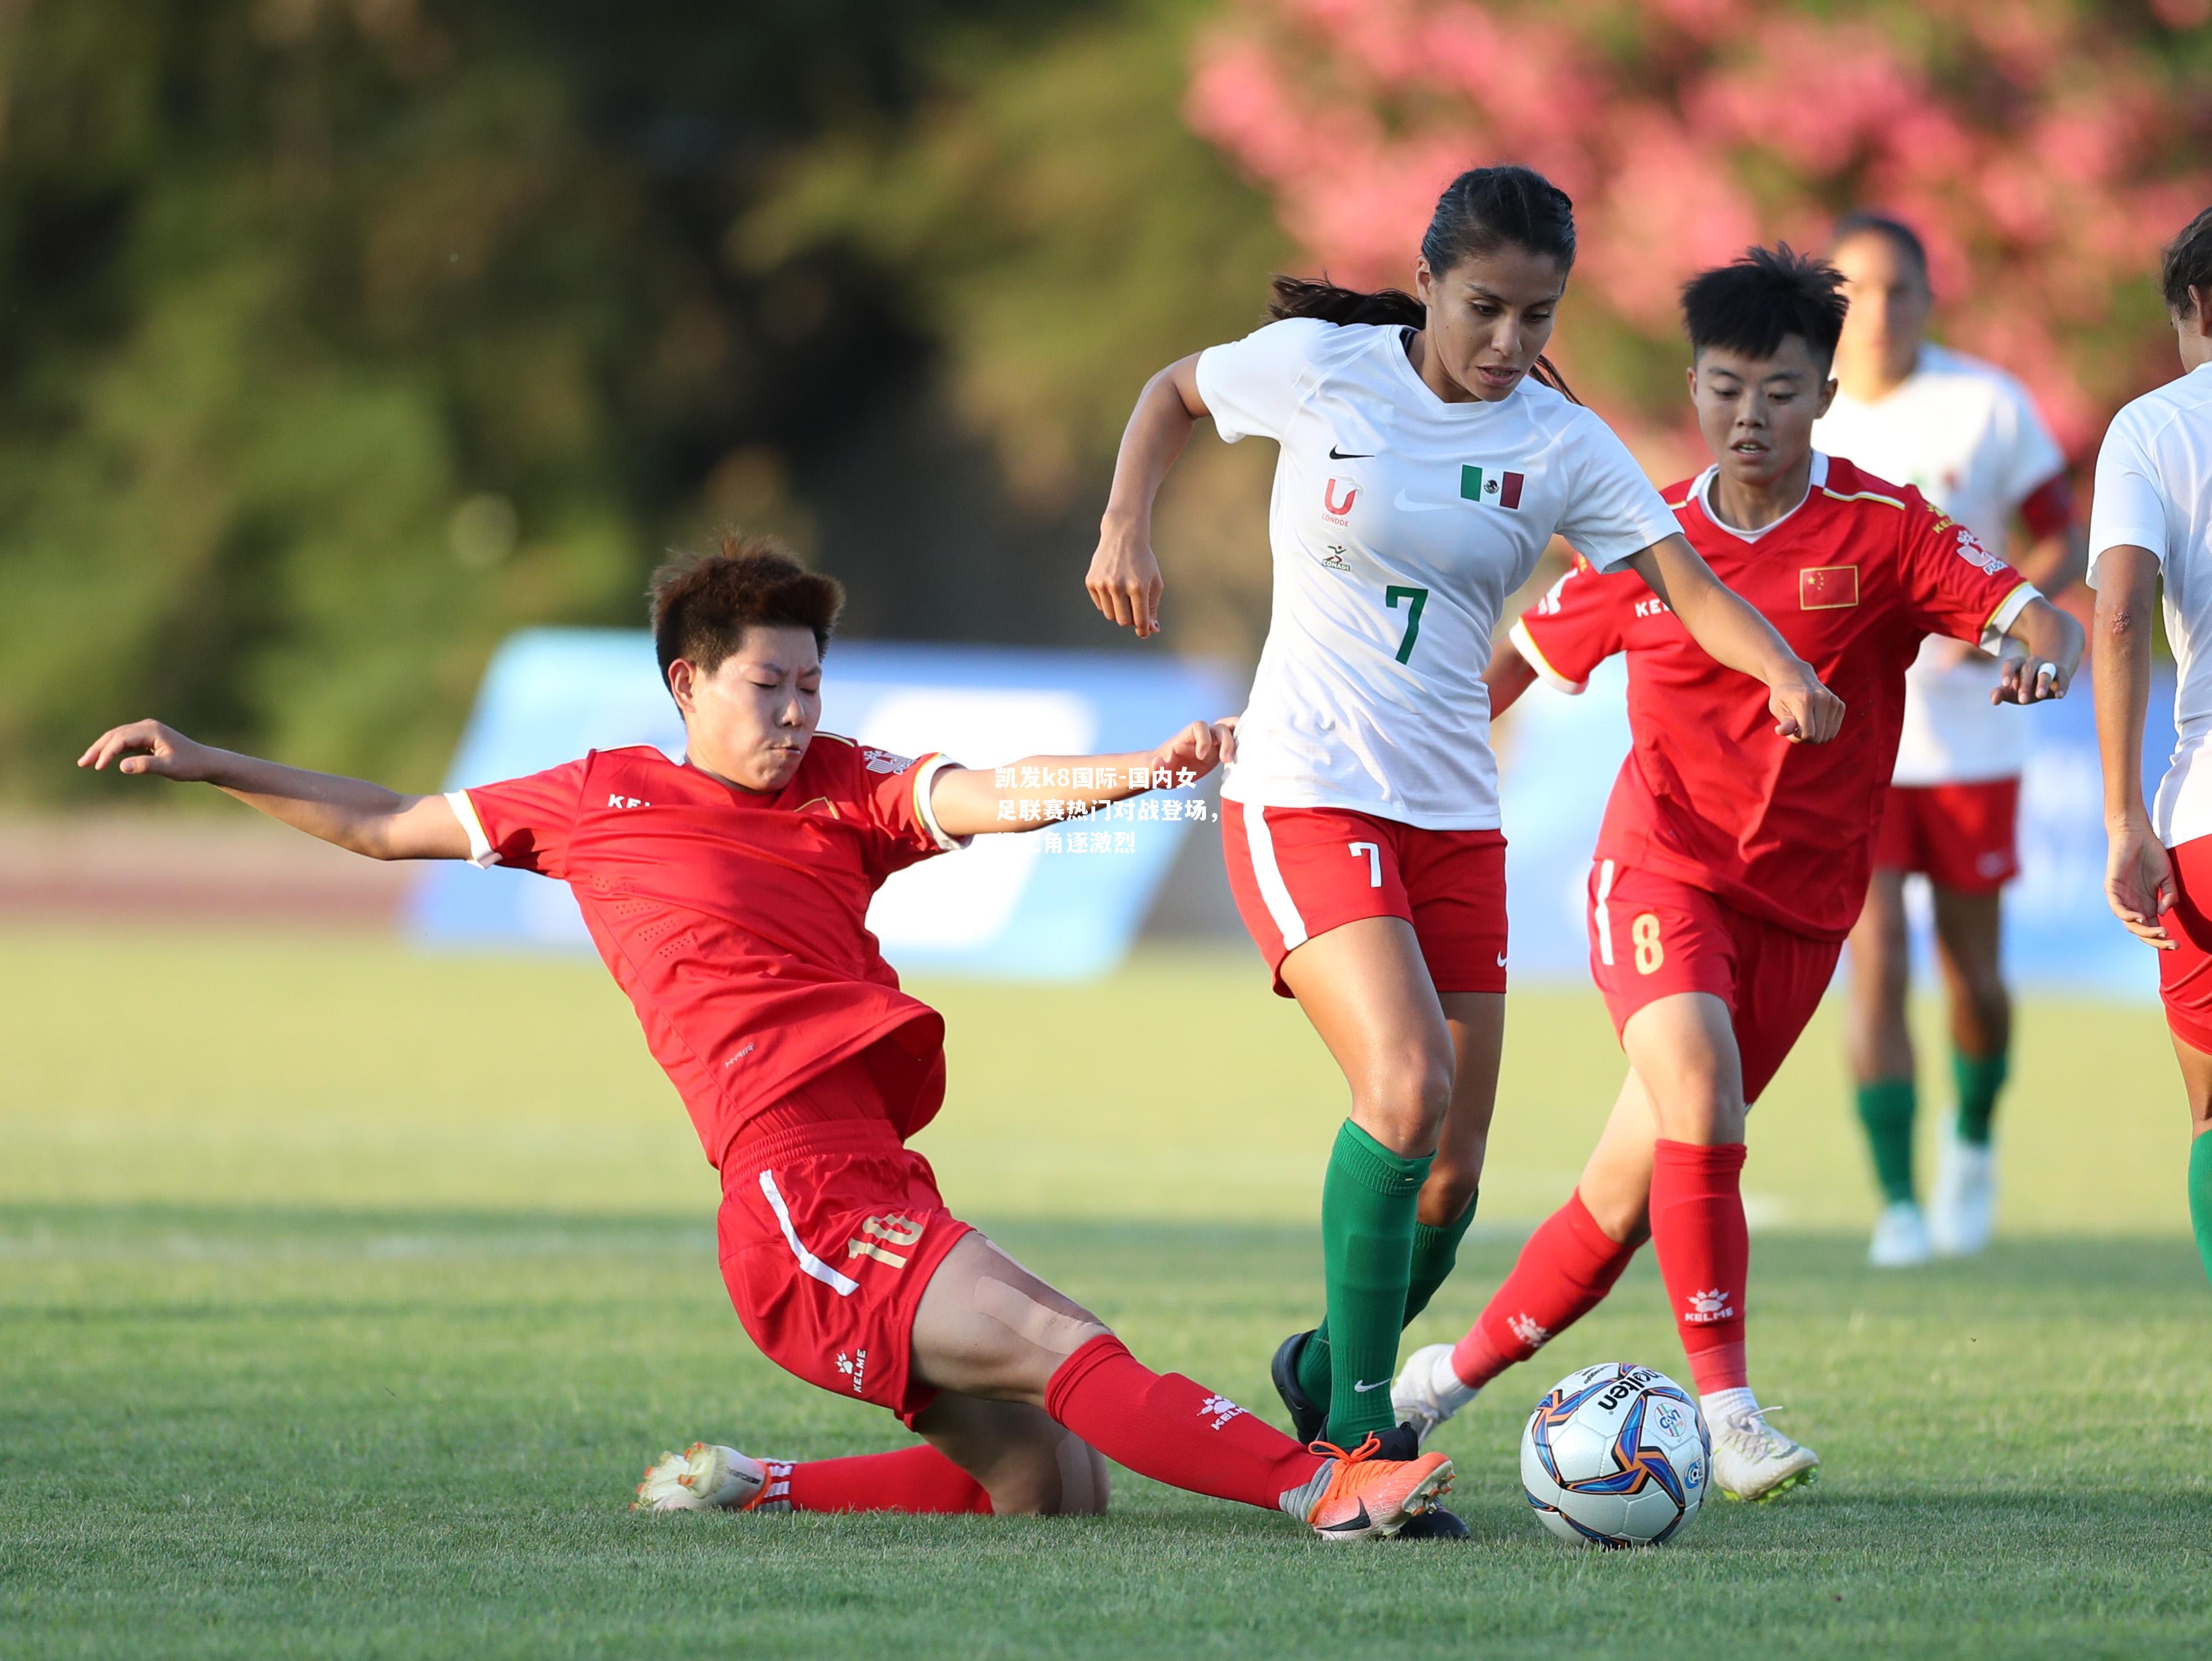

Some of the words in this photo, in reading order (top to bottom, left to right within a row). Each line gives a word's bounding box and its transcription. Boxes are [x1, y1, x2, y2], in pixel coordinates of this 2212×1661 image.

[1321, 514, 1349, 527] CONDDE
[1386, 585, 1429, 665] 7
[1348, 842, 1382, 887] 7
[1632, 914, 1664, 975] 8
[848, 1213, 923, 1269] 10
[1685, 1307, 1733, 1322] KELME
[853, 1348, 867, 1393] KELME
